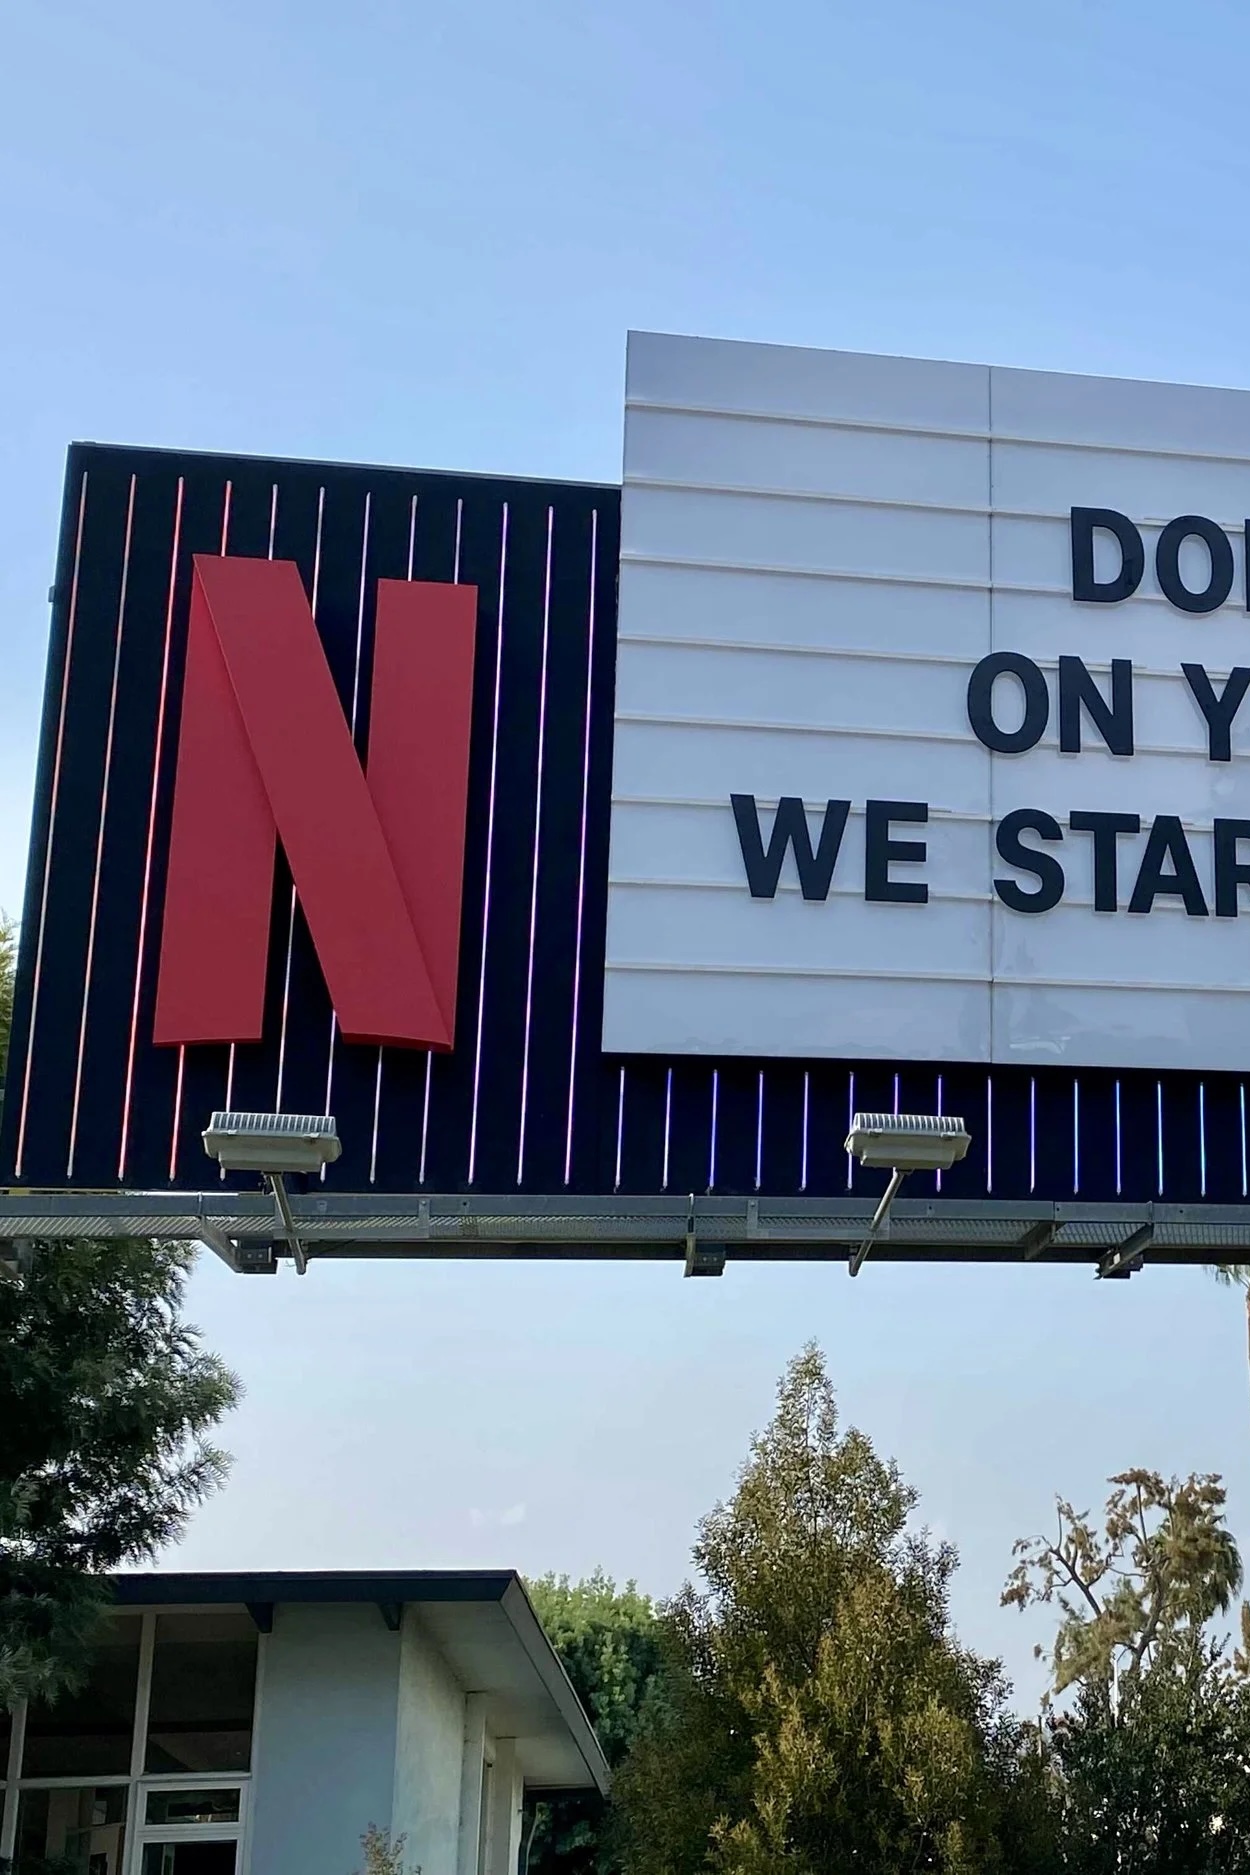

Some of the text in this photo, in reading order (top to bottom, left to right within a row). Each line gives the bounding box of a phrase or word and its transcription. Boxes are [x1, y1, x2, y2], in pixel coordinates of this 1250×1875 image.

[967, 651, 1134, 757] ON
[152, 553, 479, 1053] N
[729, 793, 929, 905] WE
